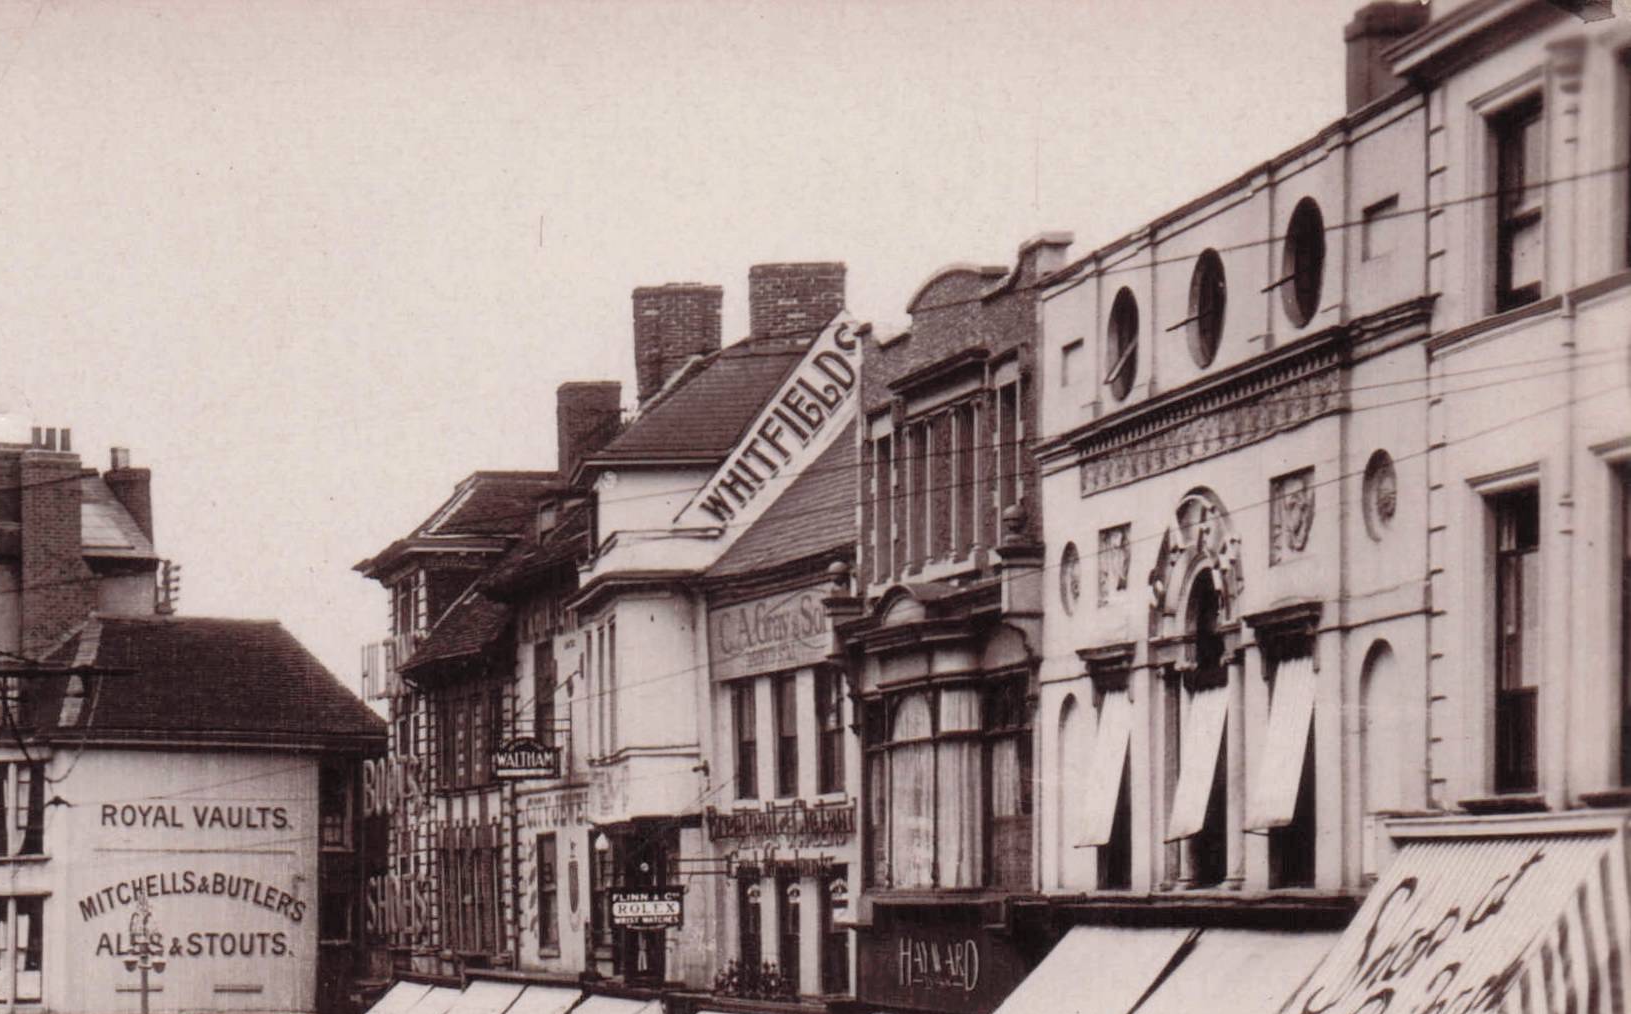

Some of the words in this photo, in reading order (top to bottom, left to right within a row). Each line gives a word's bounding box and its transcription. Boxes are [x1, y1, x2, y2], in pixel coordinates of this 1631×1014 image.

[497, 751, 554, 769] WALTHAM
[101, 805, 183, 828] ROYAL
[192, 807, 293, 830] VAULTS.
[616, 902, 677, 915] ROLEX
